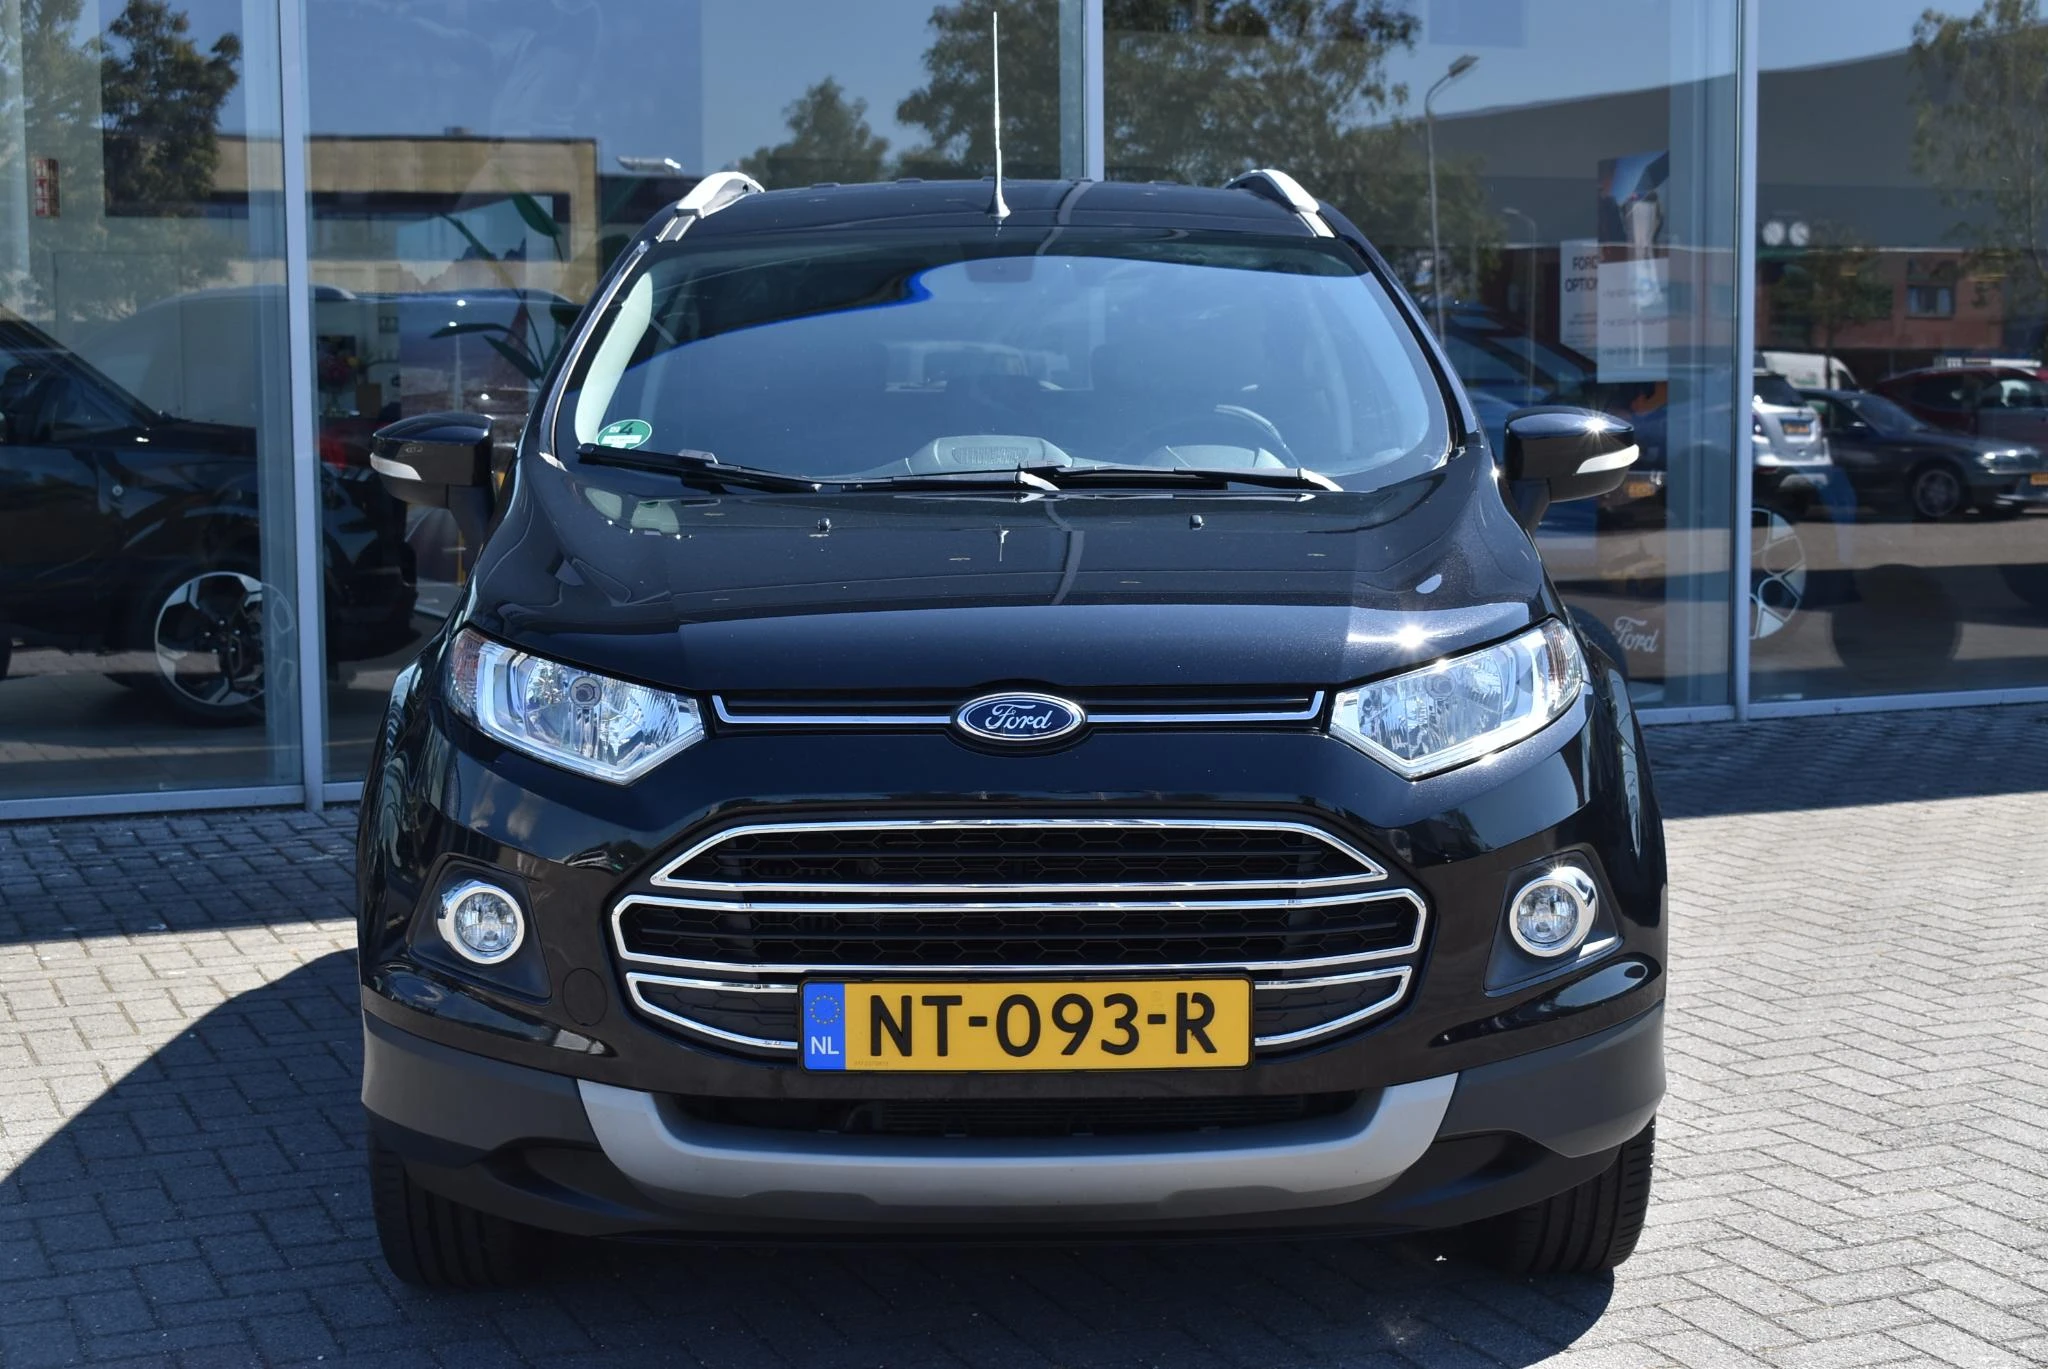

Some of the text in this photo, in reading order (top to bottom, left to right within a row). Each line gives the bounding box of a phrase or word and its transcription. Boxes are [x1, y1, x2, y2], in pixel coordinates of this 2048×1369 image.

[619, 421, 634, 436] 4
[1612, 615, 1660, 653] Ford
[985, 703, 1052, 730] Ford
[869, 992, 1218, 1057] NT-093-R
[810, 1036, 840, 1056] NL
